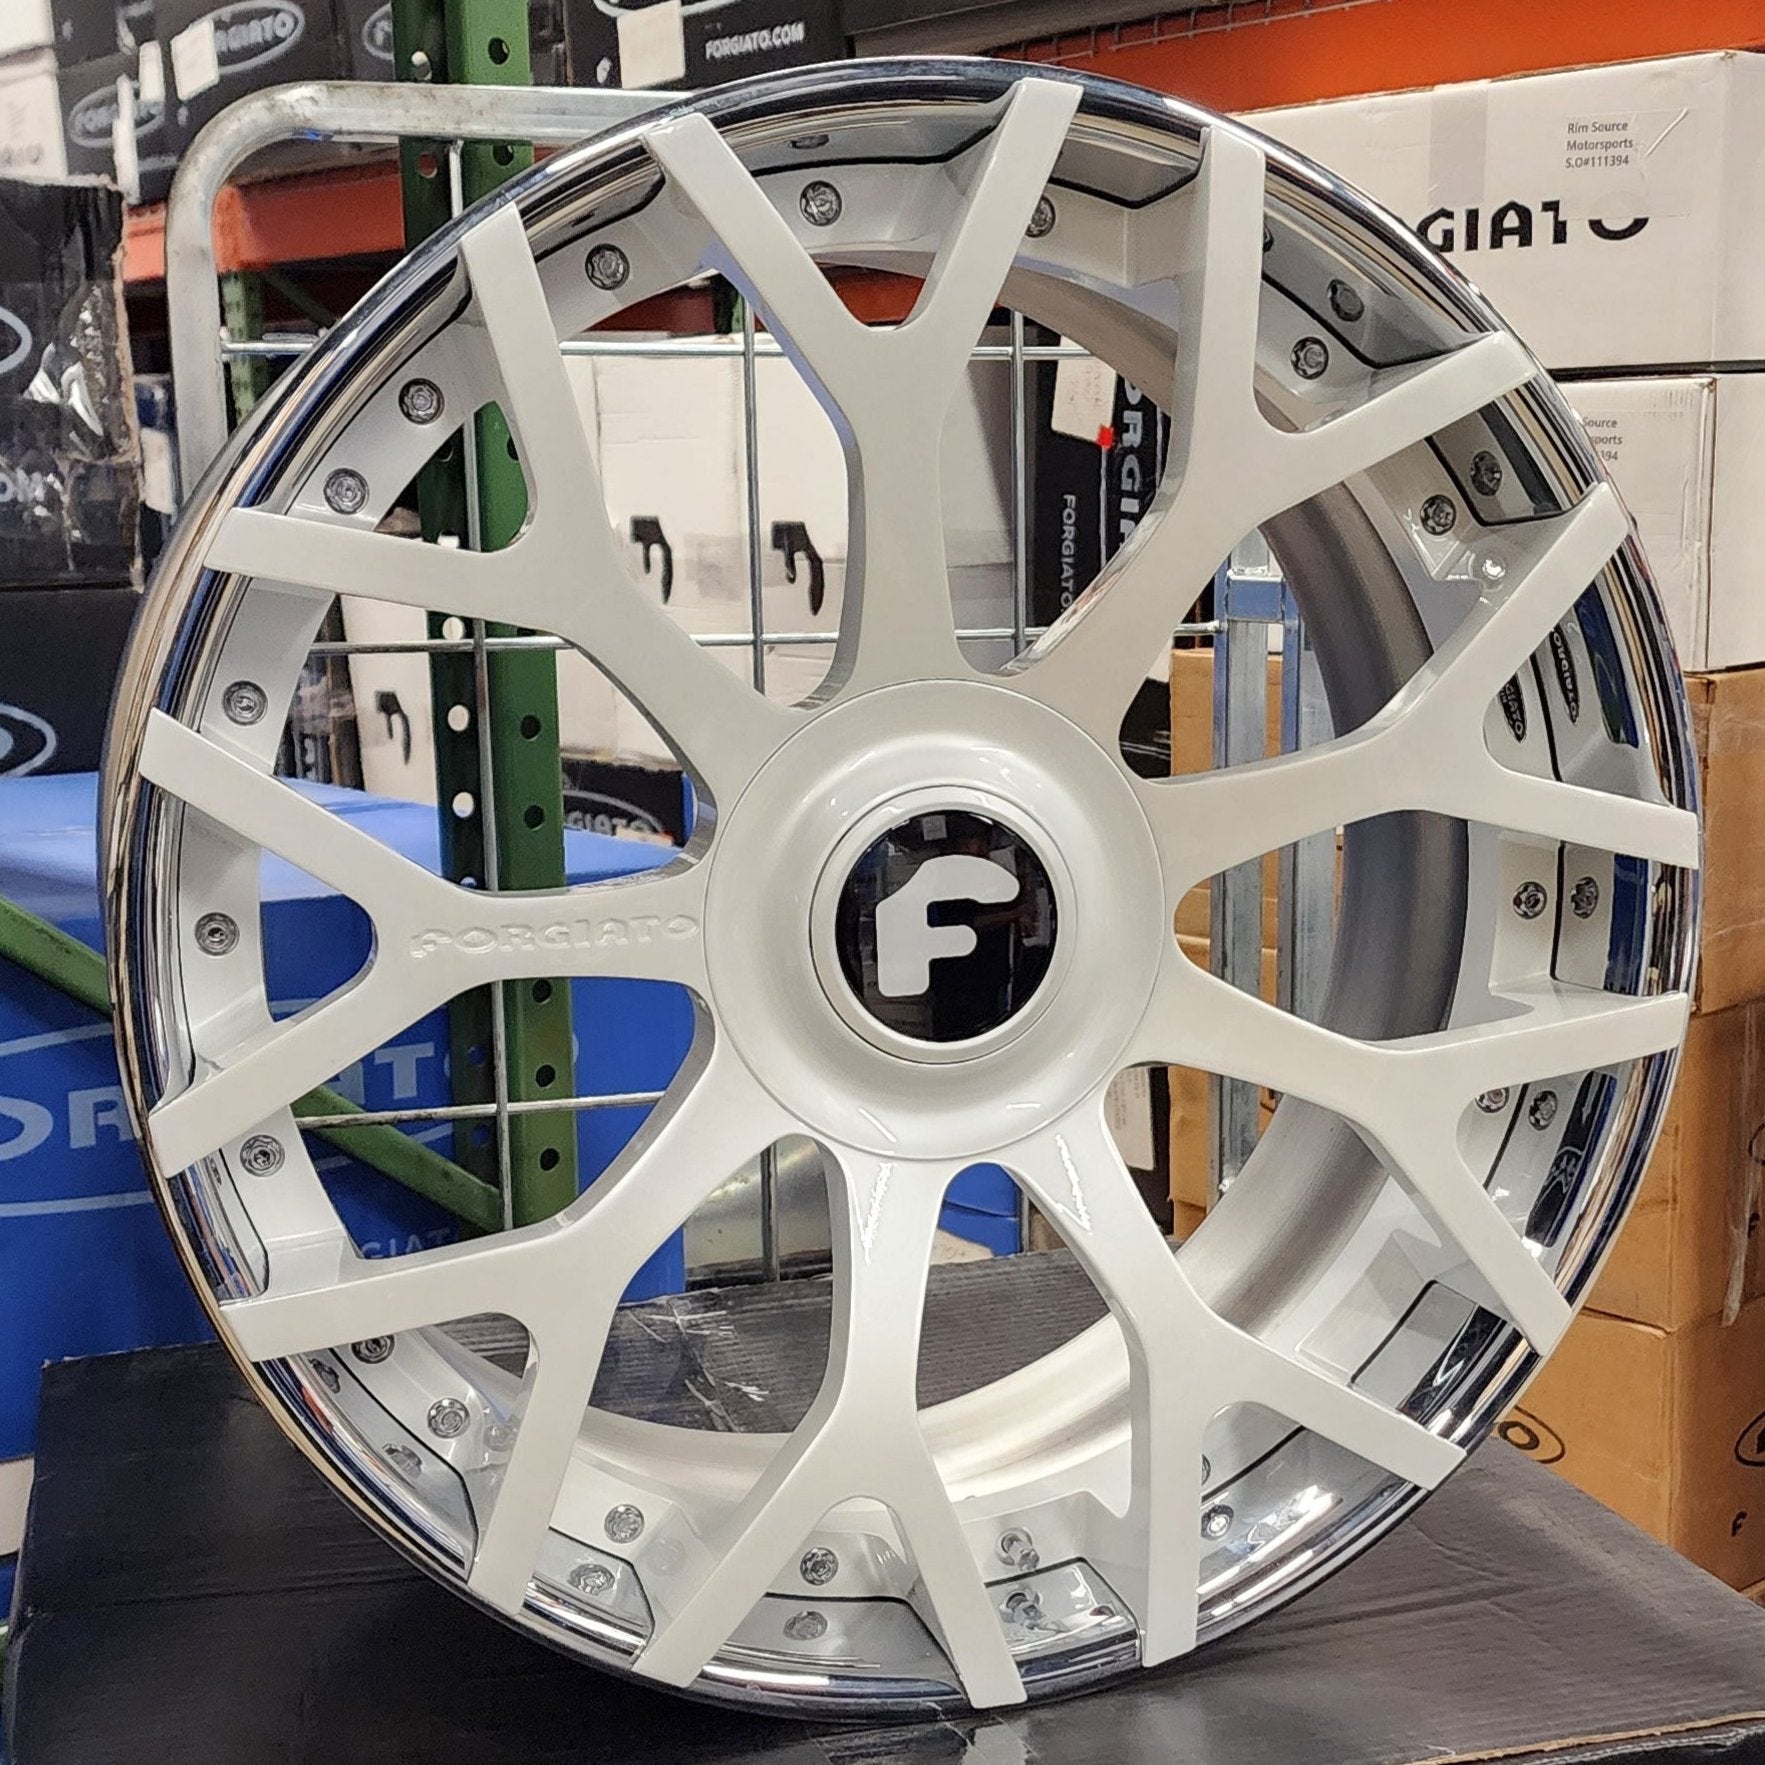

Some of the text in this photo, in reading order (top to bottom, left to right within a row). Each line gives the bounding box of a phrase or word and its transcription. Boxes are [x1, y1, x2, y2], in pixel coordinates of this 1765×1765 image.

[705, 21, 805, 60] FORGIATO.COM
[1567, 121, 1629, 134] Rim Source
[1566, 138, 1633, 152] Motorsports
[1565, 154, 1629, 169] S.O#111394
[1582, 416, 1618, 428] Source
[875, 854, 1020, 997] F
[409, 914, 699, 958] FORGIATO
